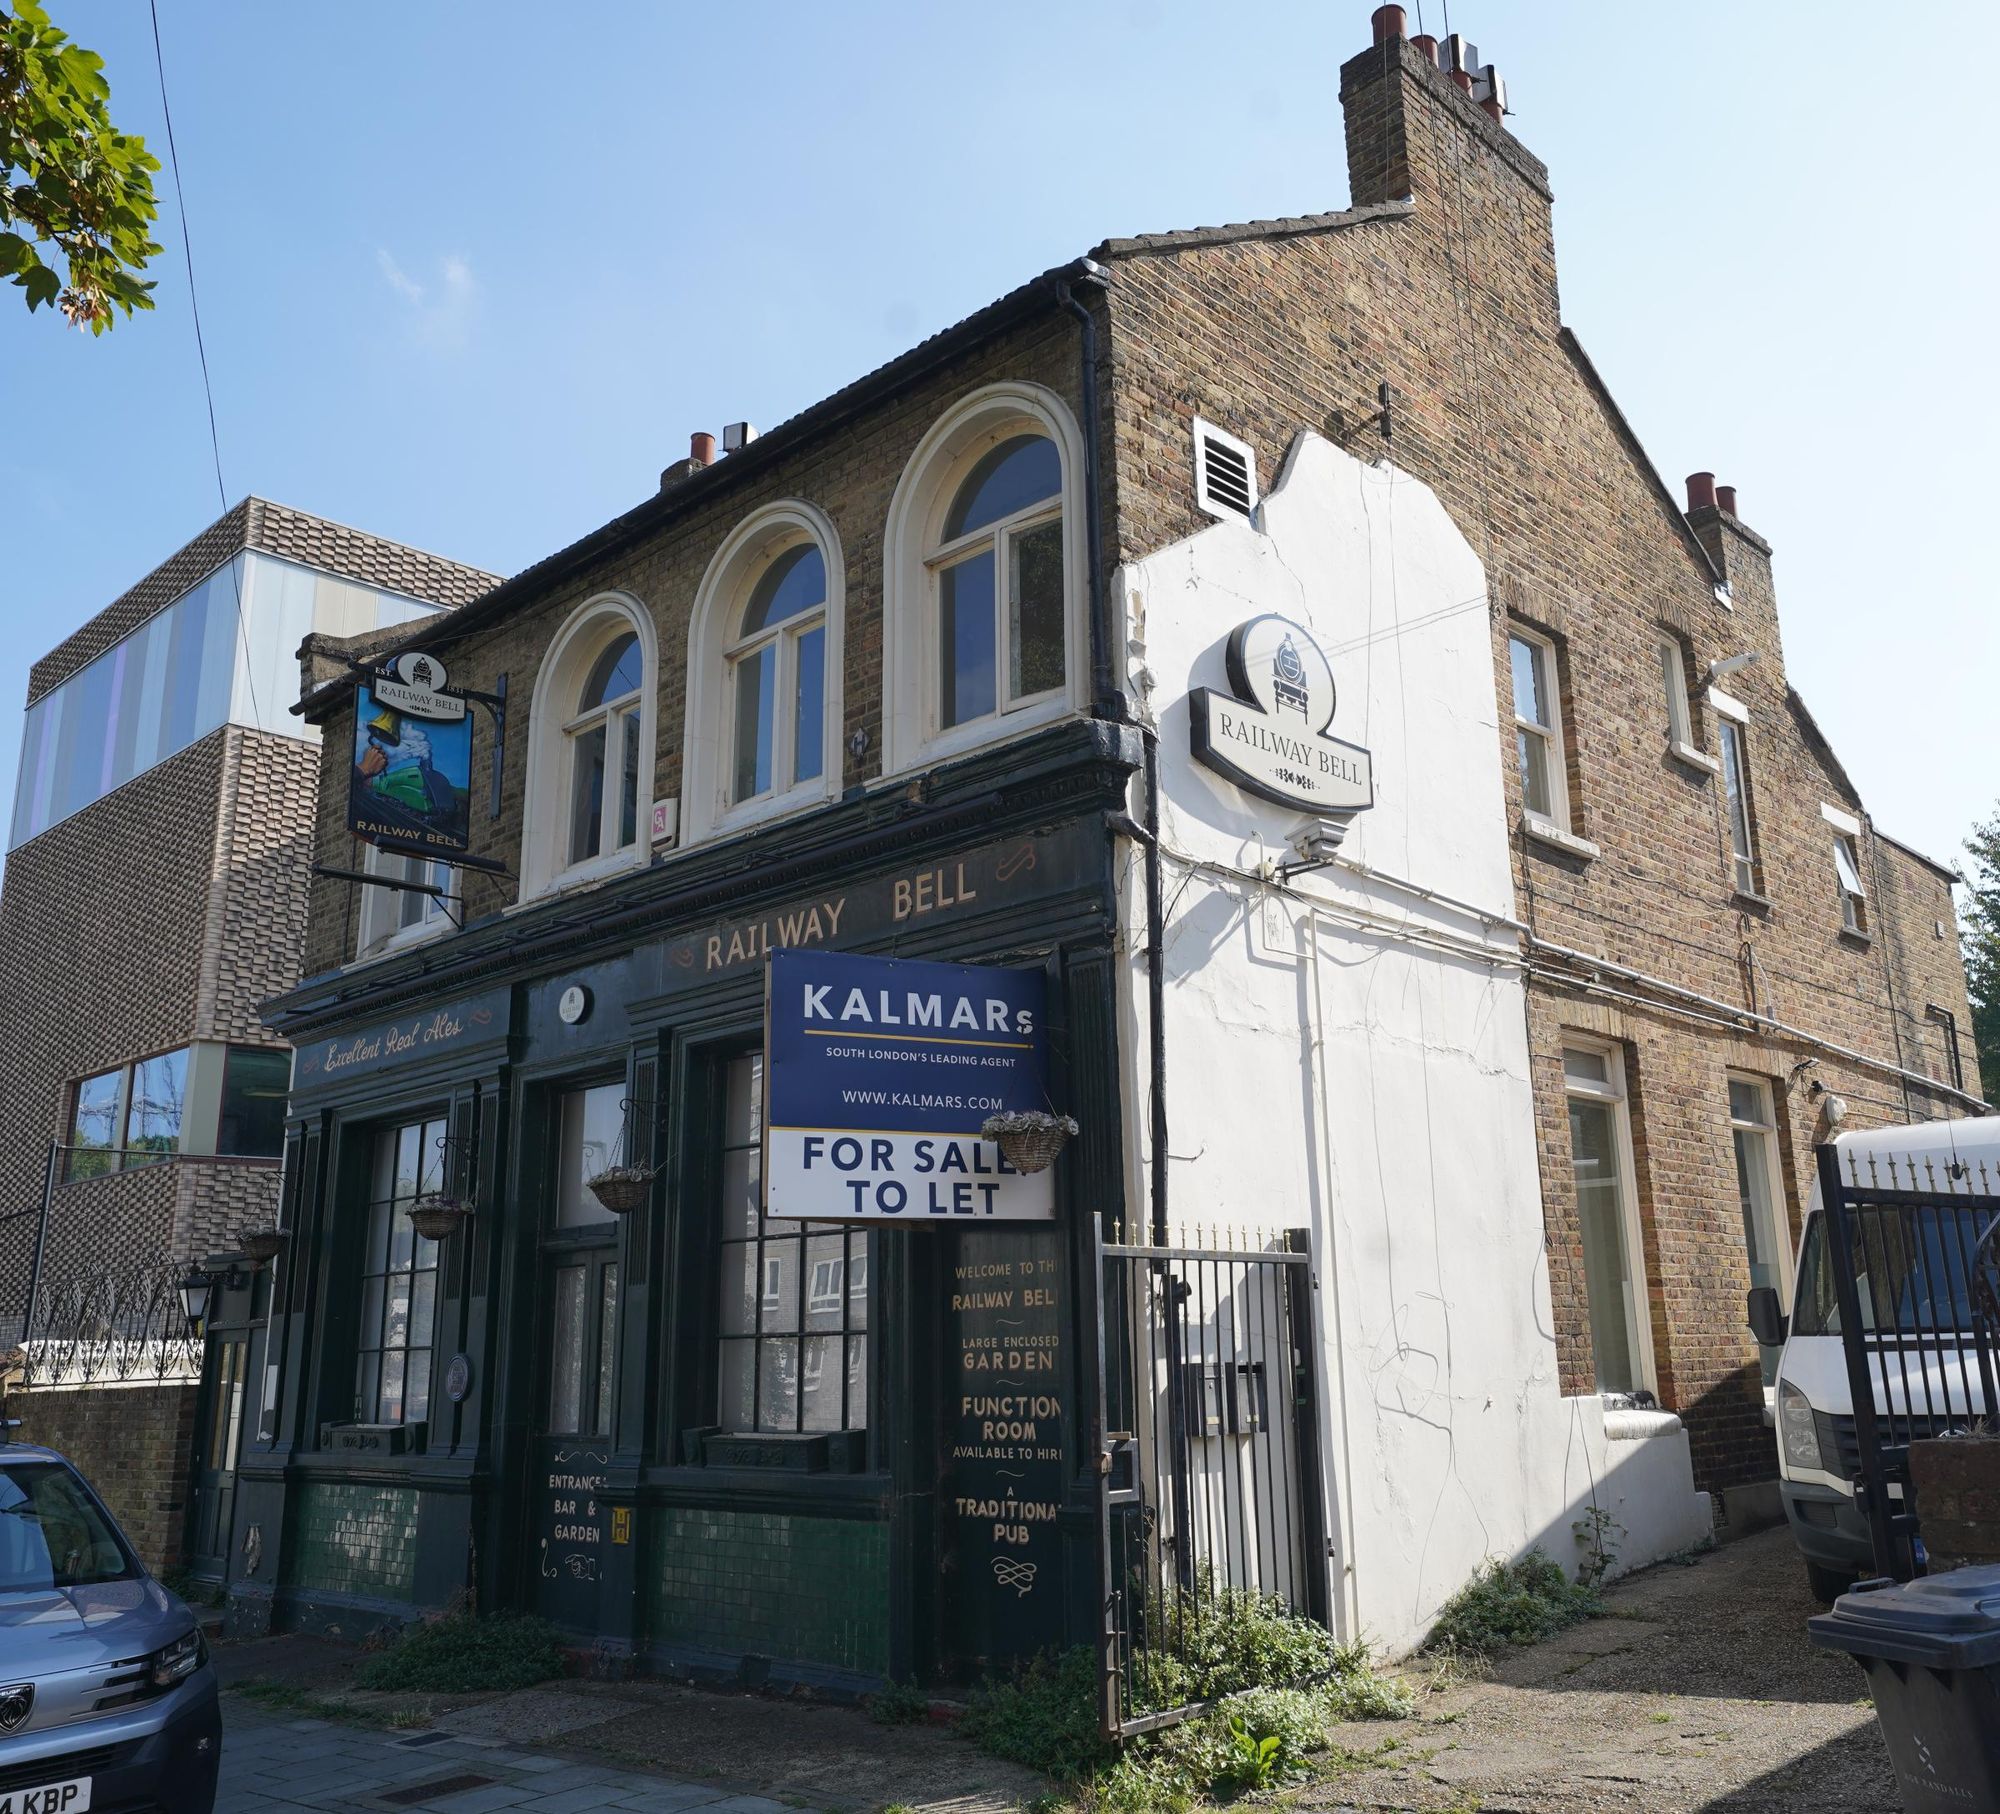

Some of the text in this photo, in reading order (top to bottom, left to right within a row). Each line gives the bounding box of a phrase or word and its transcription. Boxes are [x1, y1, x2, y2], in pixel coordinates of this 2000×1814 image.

[381, 685, 460, 713] RAILWAY BELL
[1220, 712, 1362, 785] RAILWAY BELL
[357, 820, 461, 847] RAILWAY BELL
[706, 863, 977, 969] RAILWAY BELL
[324, 1013, 463, 1072] Excellent Real Ales
[826, 1047, 1016, 1068] SOUTH LONDON'S LEADING AGENT
[842, 1090, 1003, 1110] WWW.KALMARS.COM
[803, 1136, 895, 1172] FOR
[846, 1180, 1000, 1214] TO LET
[955, 1259, 1057, 1279] WELCOME TO TH
[952, 1288, 1058, 1310] RAILWAY BEL
[962, 1336, 1059, 1349] LARGE ENCLOSED
[964, 1351, 1053, 1369] GARDEN
[962, 1396, 1061, 1417] FUNCTION
[983, 1421, 1036, 1441] ROOM
[953, 1446, 1014, 1459] AVAILABLE
[1018, 1447, 1032, 1460] TO
[549, 1475, 607, 1490] ENTRANCE
[1007, 1486, 1014, 1497] A
[554, 1500, 596, 1516] BAR &
[956, 1498, 1062, 1521] TRADITIONA
[554, 1525, 600, 1543] GARDEN
[993, 1523, 1029, 1543] PUB
[23, 1784, 78, 1814] KBP
